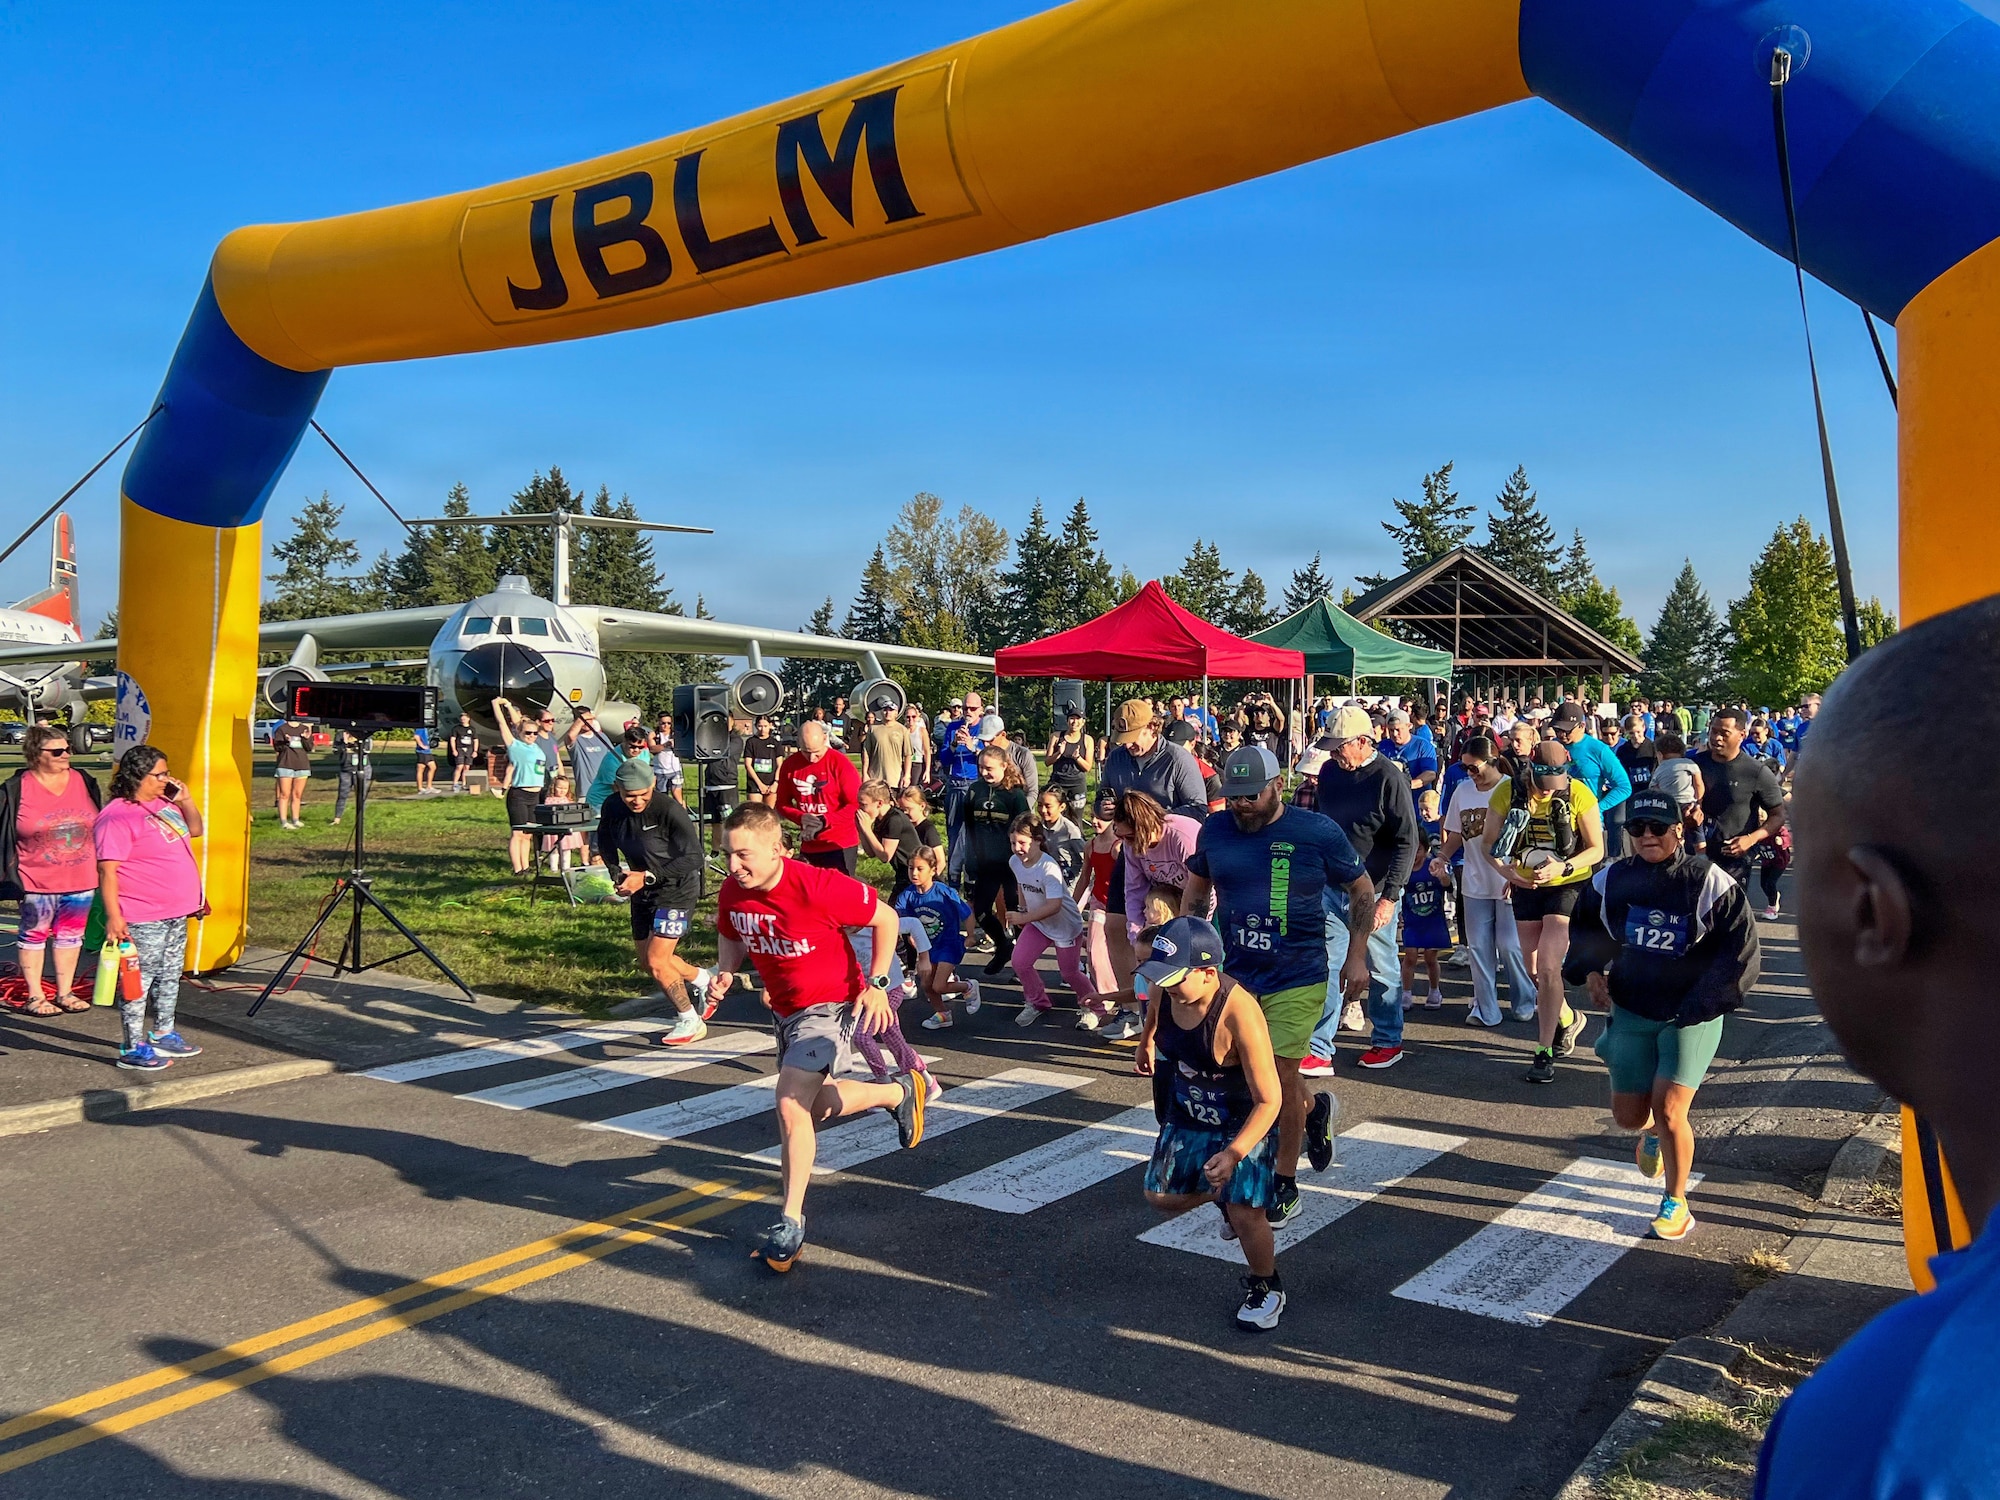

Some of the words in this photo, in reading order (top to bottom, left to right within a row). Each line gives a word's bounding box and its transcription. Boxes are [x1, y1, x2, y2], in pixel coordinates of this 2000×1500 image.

[507, 84, 926, 310] JBLM
[1633, 773, 1648, 783] 101
[799, 802, 828, 813] RWG
[1412, 890, 1435, 905] 107
[729, 910, 777, 937] DON'T
[1264, 917, 1273, 927] 1K
[1669, 914, 1680, 925] 1K
[659, 920, 683, 936] 133
[1237, 928, 1272, 951] 125
[1634, 926, 1676, 951] 122
[1206, 1091, 1217, 1102] 1K
[1183, 1099, 1222, 1126] 123
